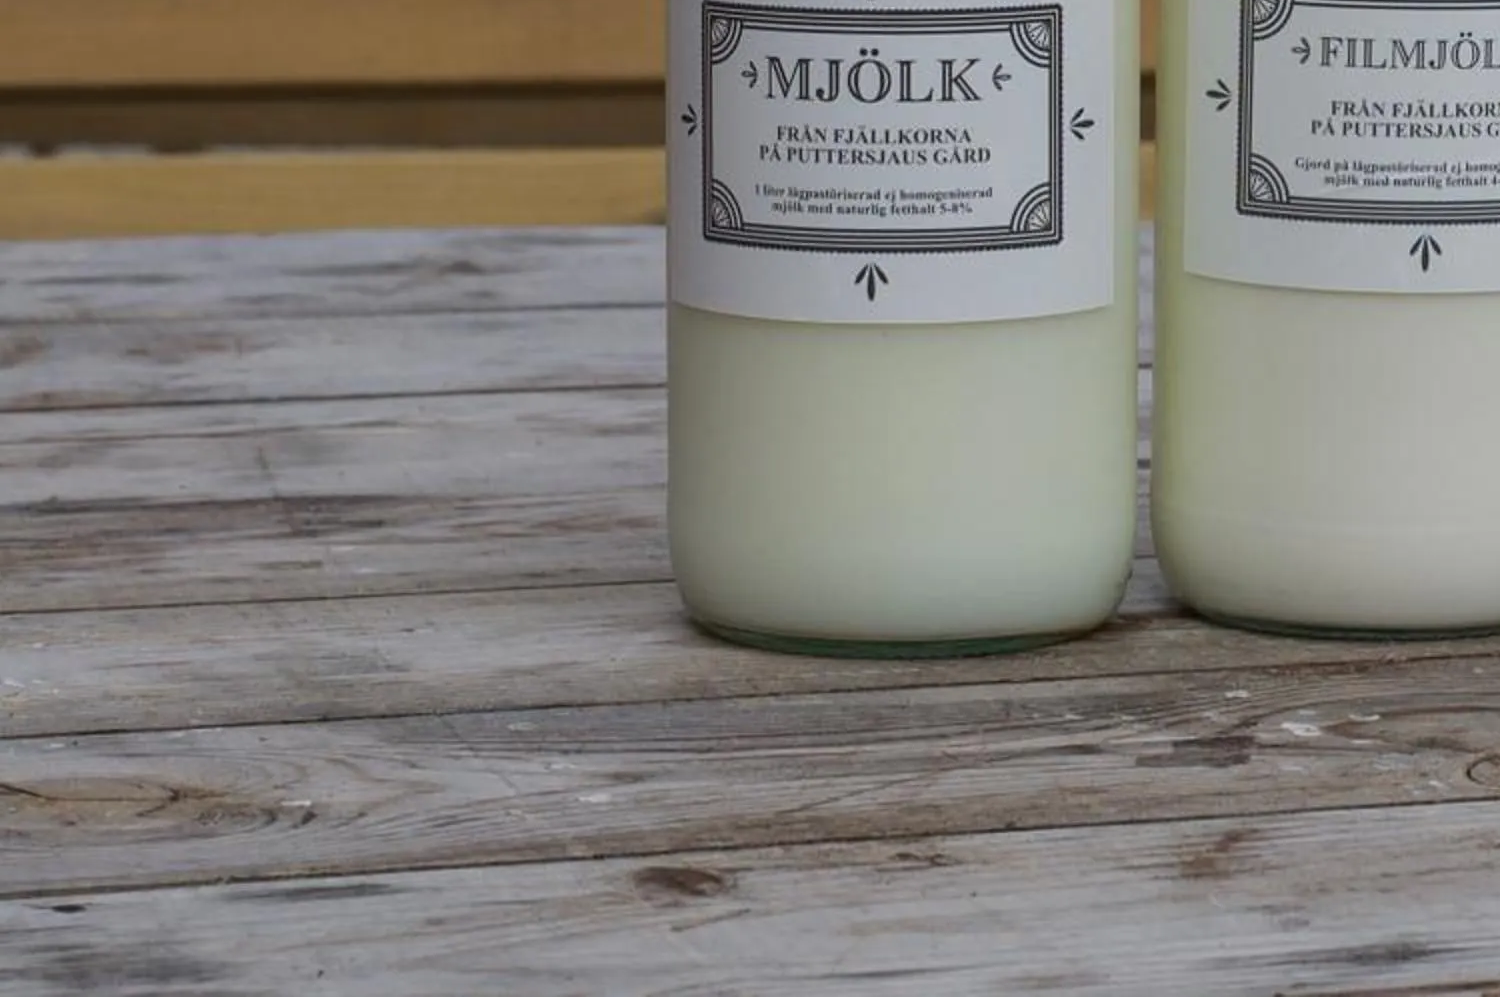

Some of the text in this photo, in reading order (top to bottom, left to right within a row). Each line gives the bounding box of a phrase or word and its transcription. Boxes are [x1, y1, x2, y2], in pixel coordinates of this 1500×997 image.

[766, 48, 982, 103] MJÖLK
[1331, 99, 1386, 118] FRÅN
[777, 124, 972, 146] FRÅN FJÄLLKORNA
[1311, 117, 1335, 136] PÅ
[1342, 120, 1482, 139] PUTTERSJAUS
[759, 143, 992, 166] PÅ PUTTERSJAUS GÅRD
[1295, 157, 1331, 171] Gjord
[1334, 160, 1349, 173] på
[1451, 163, 1462, 175] ej
[1363, 175, 1389, 187] med
[1393, 175, 1443, 189] naturlig
[884, 190, 896, 201] ej
[808, 203, 833, 214] med
[836, 203, 887, 218] naturlig
